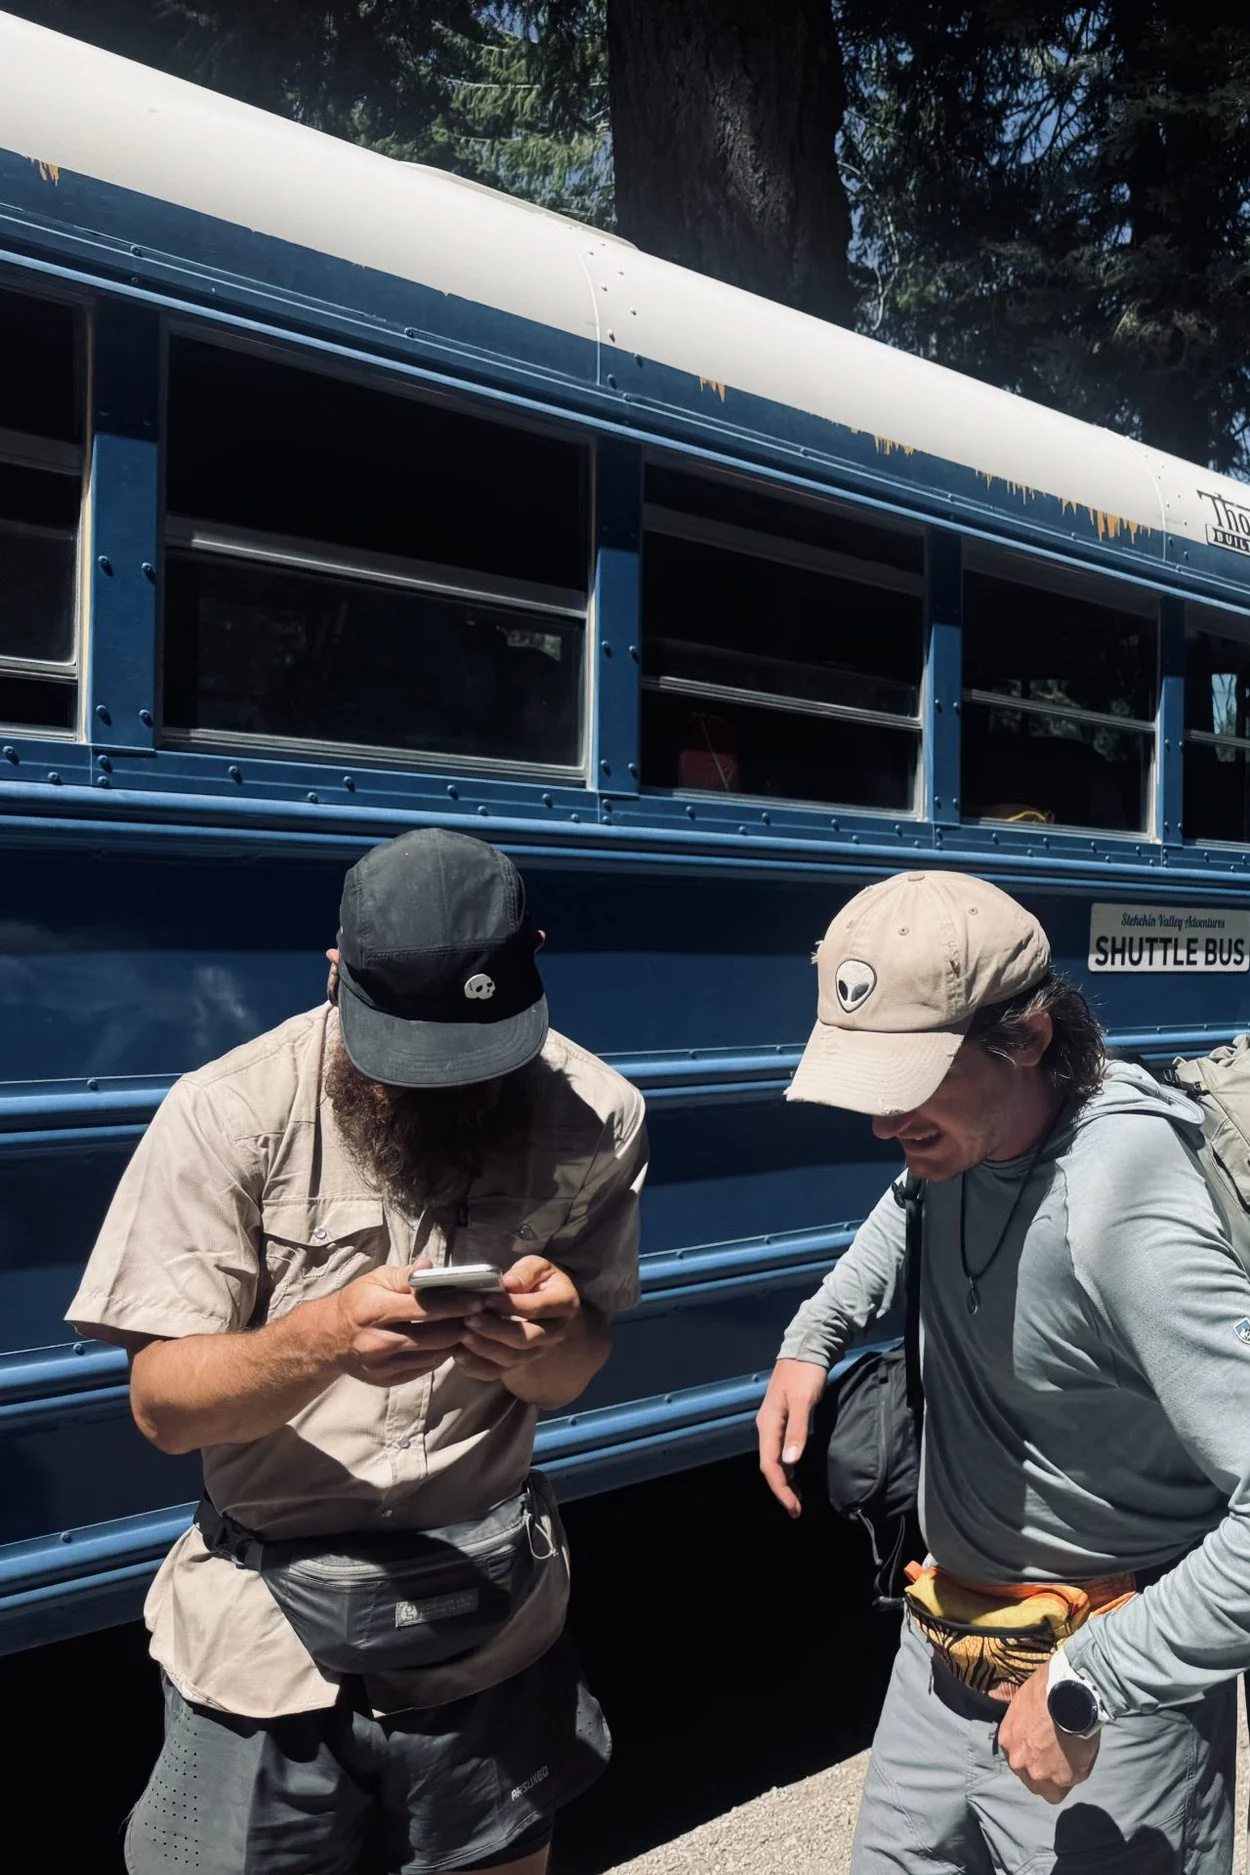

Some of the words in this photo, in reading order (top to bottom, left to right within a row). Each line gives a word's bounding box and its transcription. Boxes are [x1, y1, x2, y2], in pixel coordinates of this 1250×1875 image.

[1121, 912, 1156, 928] Stehekin
[1158, 914, 1183, 931] Valley
[1184, 915, 1226, 930] Adventures
[1094, 935, 1198, 967] SHUTTLE
[1204, 937, 1244, 967] BUS
[511, 1765, 549, 1801] ARSUXEO
